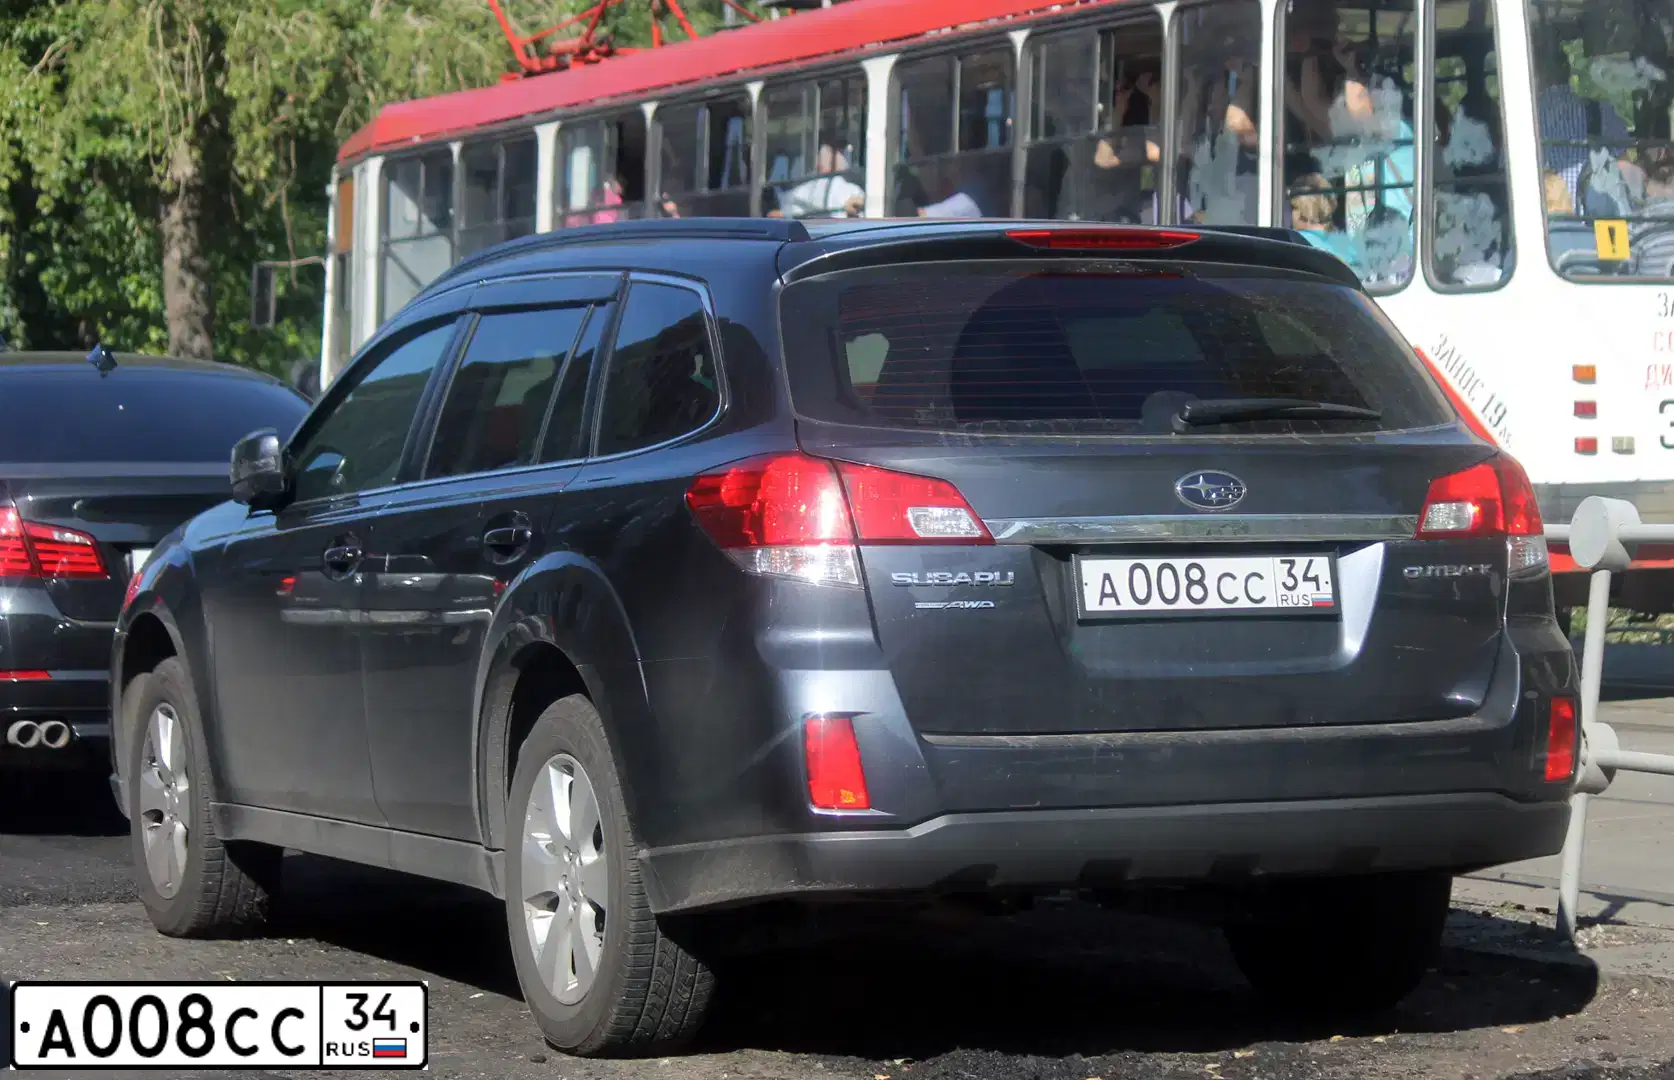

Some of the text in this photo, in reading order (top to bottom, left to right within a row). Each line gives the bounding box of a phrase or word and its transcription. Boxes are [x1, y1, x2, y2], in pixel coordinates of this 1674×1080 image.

[1431, 333, 1485, 402] ЗАНОС
[891, 571, 1015, 586] SUBARU
[1279, 558, 1321, 592] 34
[1280, 593, 1310, 607] RUS
